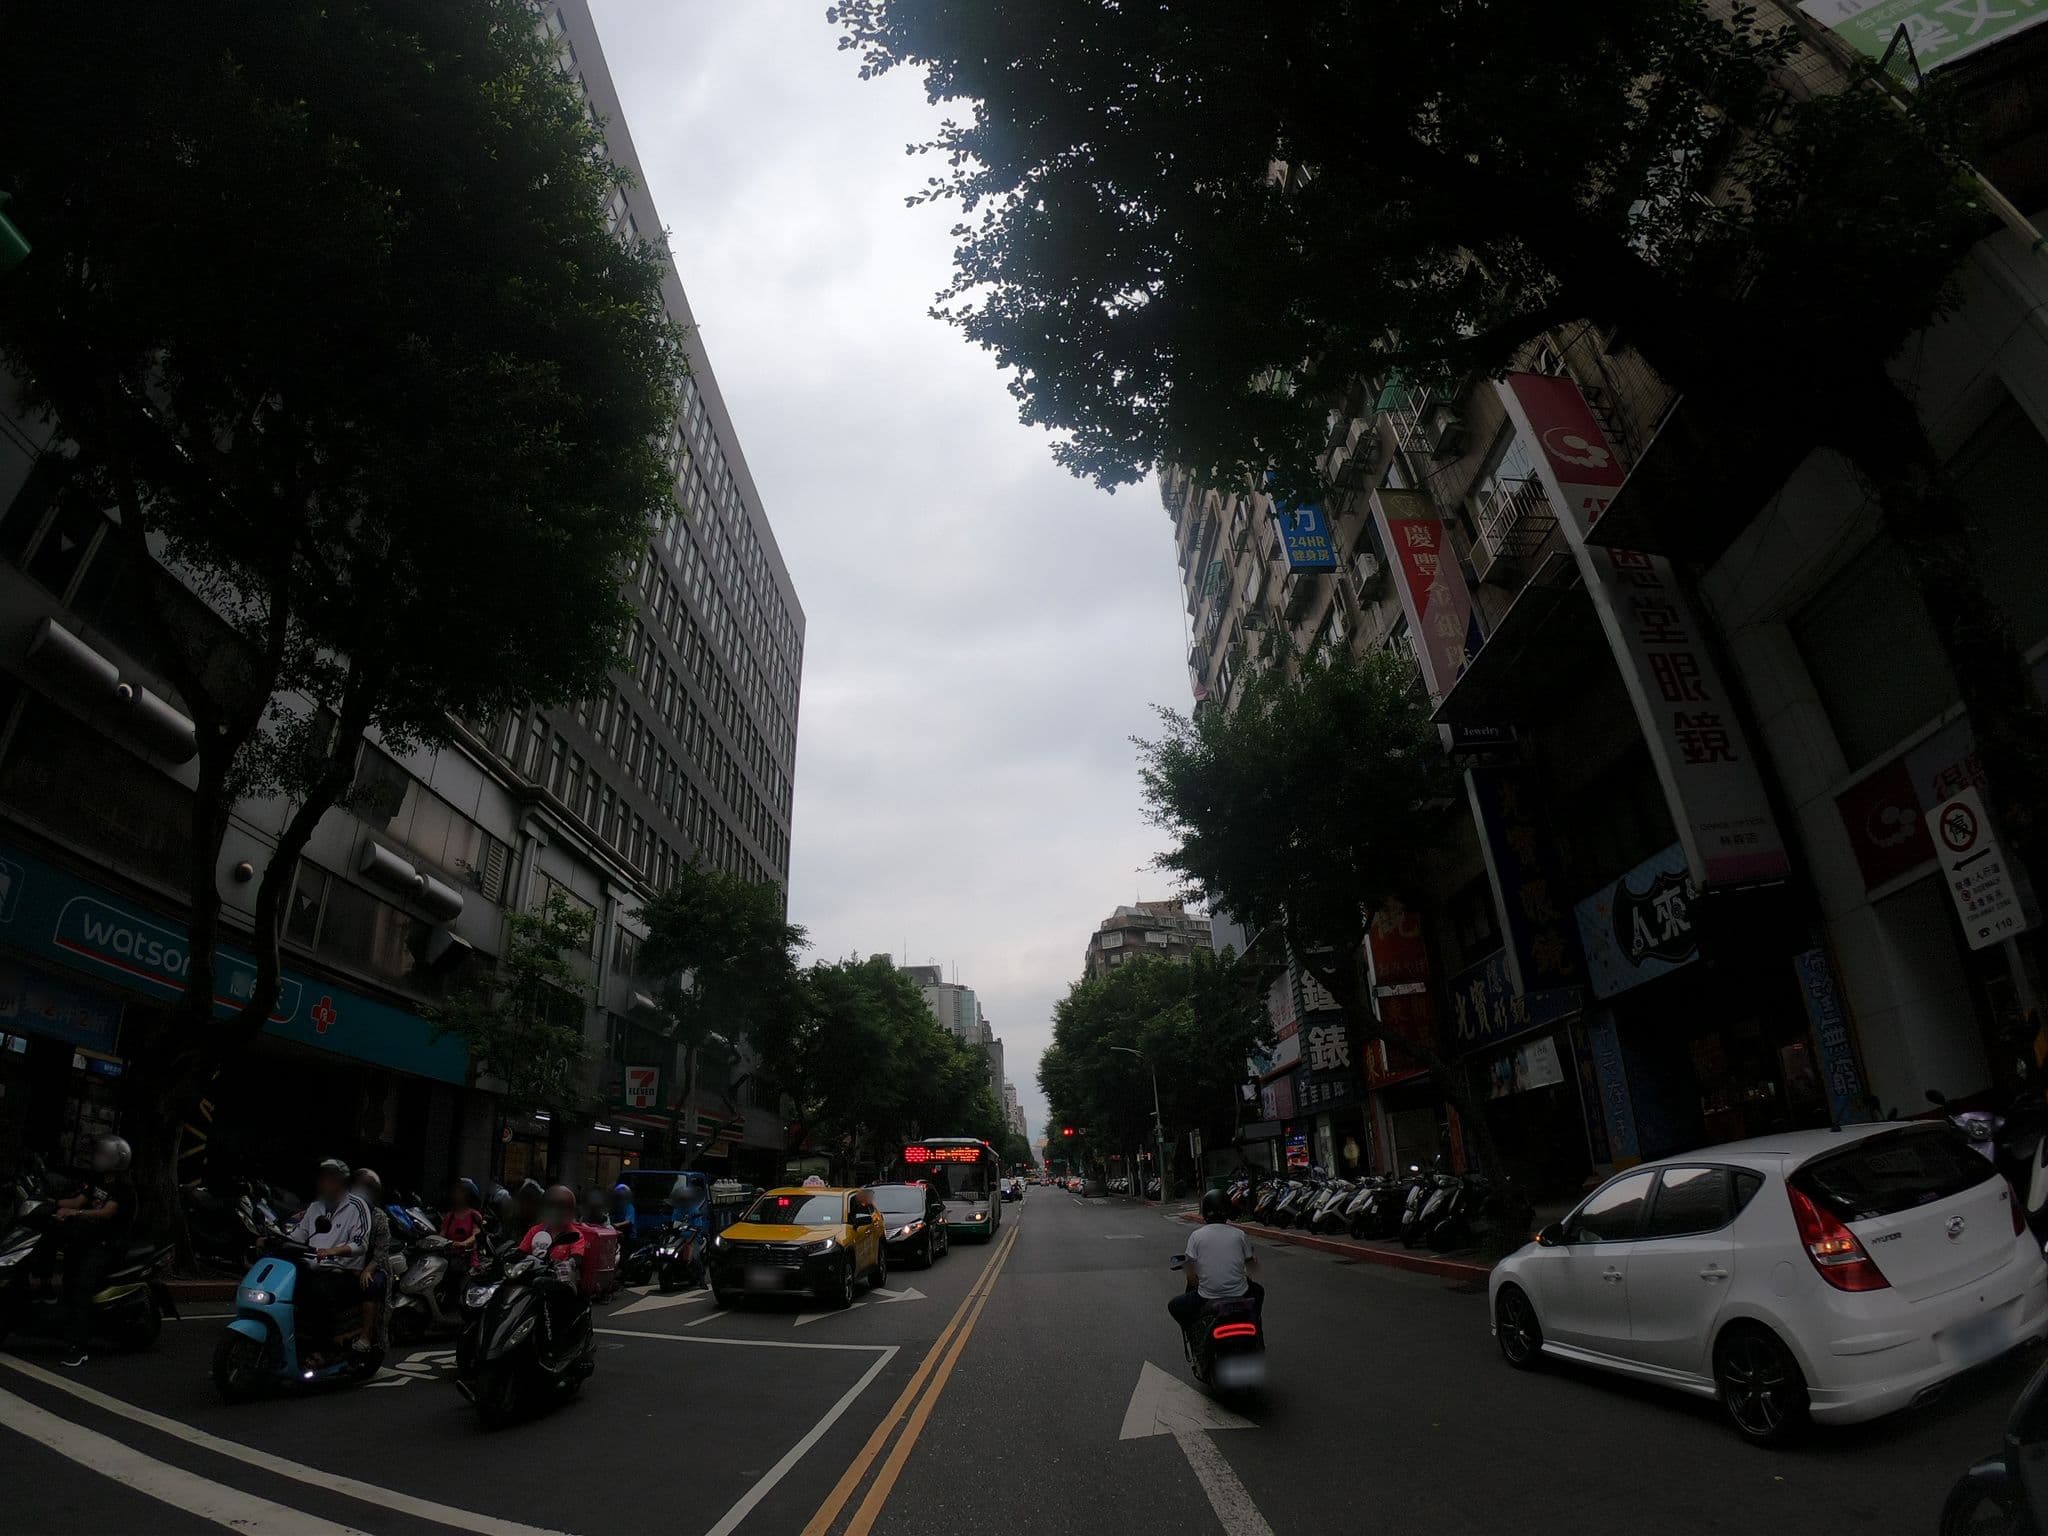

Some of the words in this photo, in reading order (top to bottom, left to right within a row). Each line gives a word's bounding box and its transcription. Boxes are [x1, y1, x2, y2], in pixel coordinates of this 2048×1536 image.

[1288, 536, 1326, 548] 24HR
[1995, 917, 2012, 933] 110
[1302, 945, 1351, 1072] 鐘錶
[630, 1070, 655, 1107] 7
